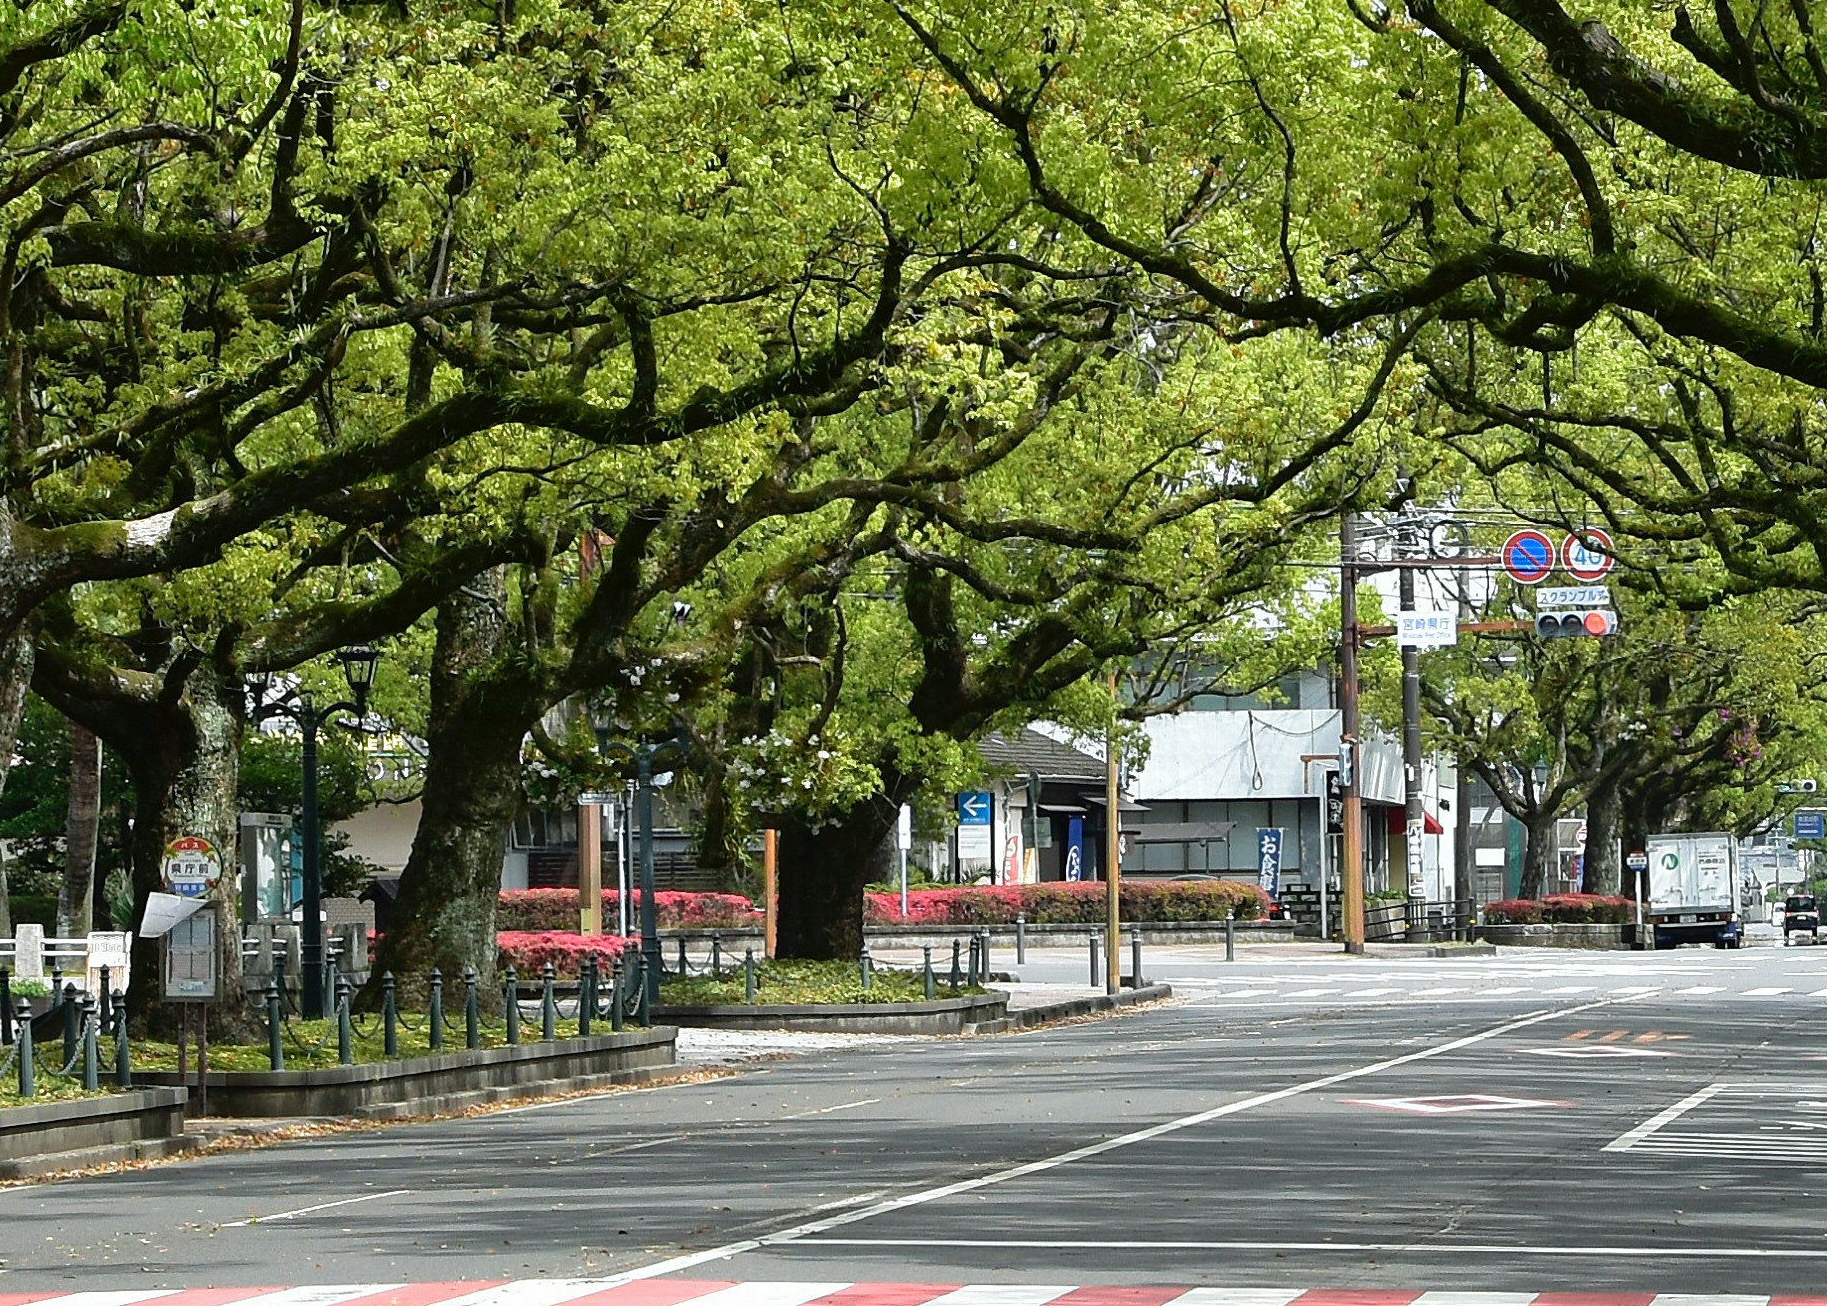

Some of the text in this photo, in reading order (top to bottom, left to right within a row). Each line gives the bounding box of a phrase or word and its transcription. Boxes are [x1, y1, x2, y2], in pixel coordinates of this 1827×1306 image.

[1574, 545, 1602, 565] 40
[171, 863, 209, 874] 県庁前
[1260, 835, 1278, 891] お食事
